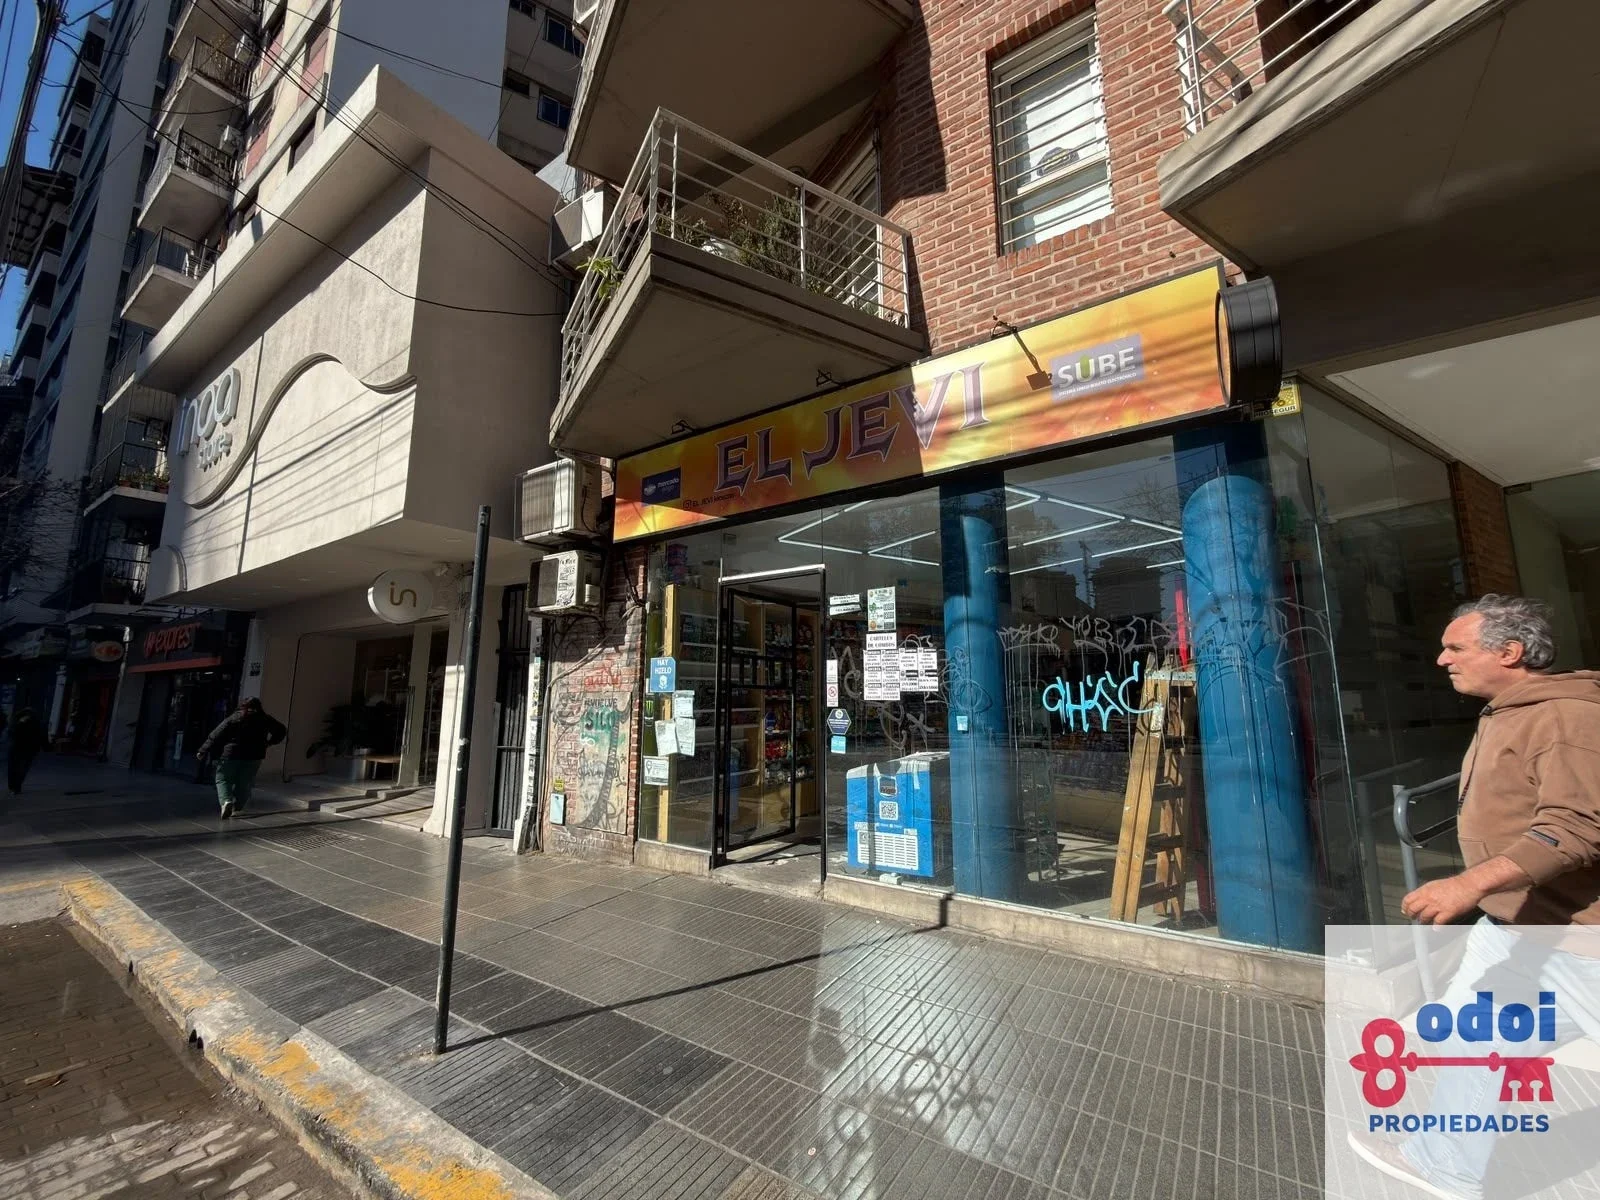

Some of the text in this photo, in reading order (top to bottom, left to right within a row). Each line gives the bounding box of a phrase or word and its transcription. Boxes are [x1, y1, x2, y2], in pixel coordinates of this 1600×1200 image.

[1057, 347, 1136, 388] SUBE
[713, 361, 991, 497] EL JEVI
[654, 666, 672, 675] HIELO
